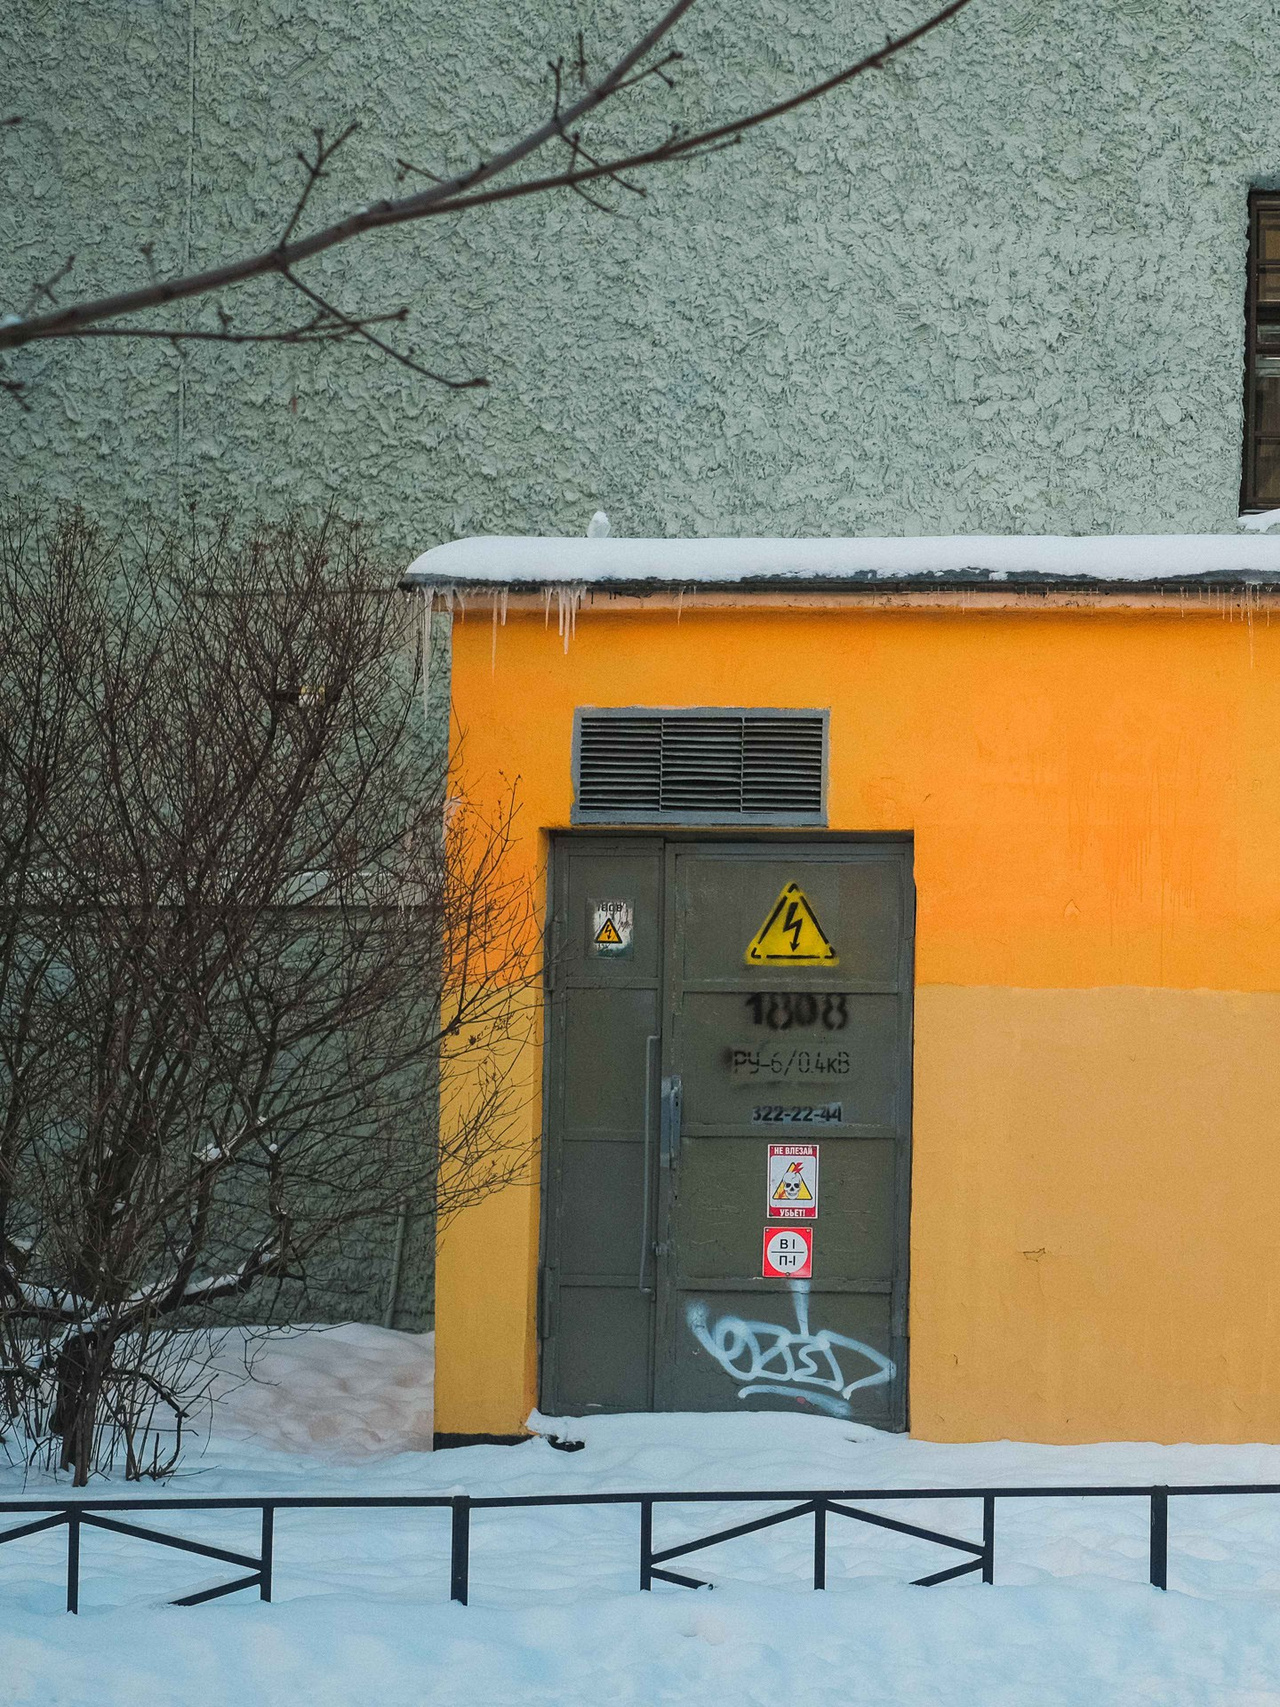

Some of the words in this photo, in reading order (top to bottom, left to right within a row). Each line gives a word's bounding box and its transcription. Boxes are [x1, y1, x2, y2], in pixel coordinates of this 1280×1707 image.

[745, 992, 848, 1031] 1808
[753, 1105, 842, 1122] 322-22-44
[774, 1146, 784, 1155] НЕ
[785, 1146, 813, 1155] ВЛЕЗАЙ
[780, 1208, 805, 1217] УБЬЕТ!
